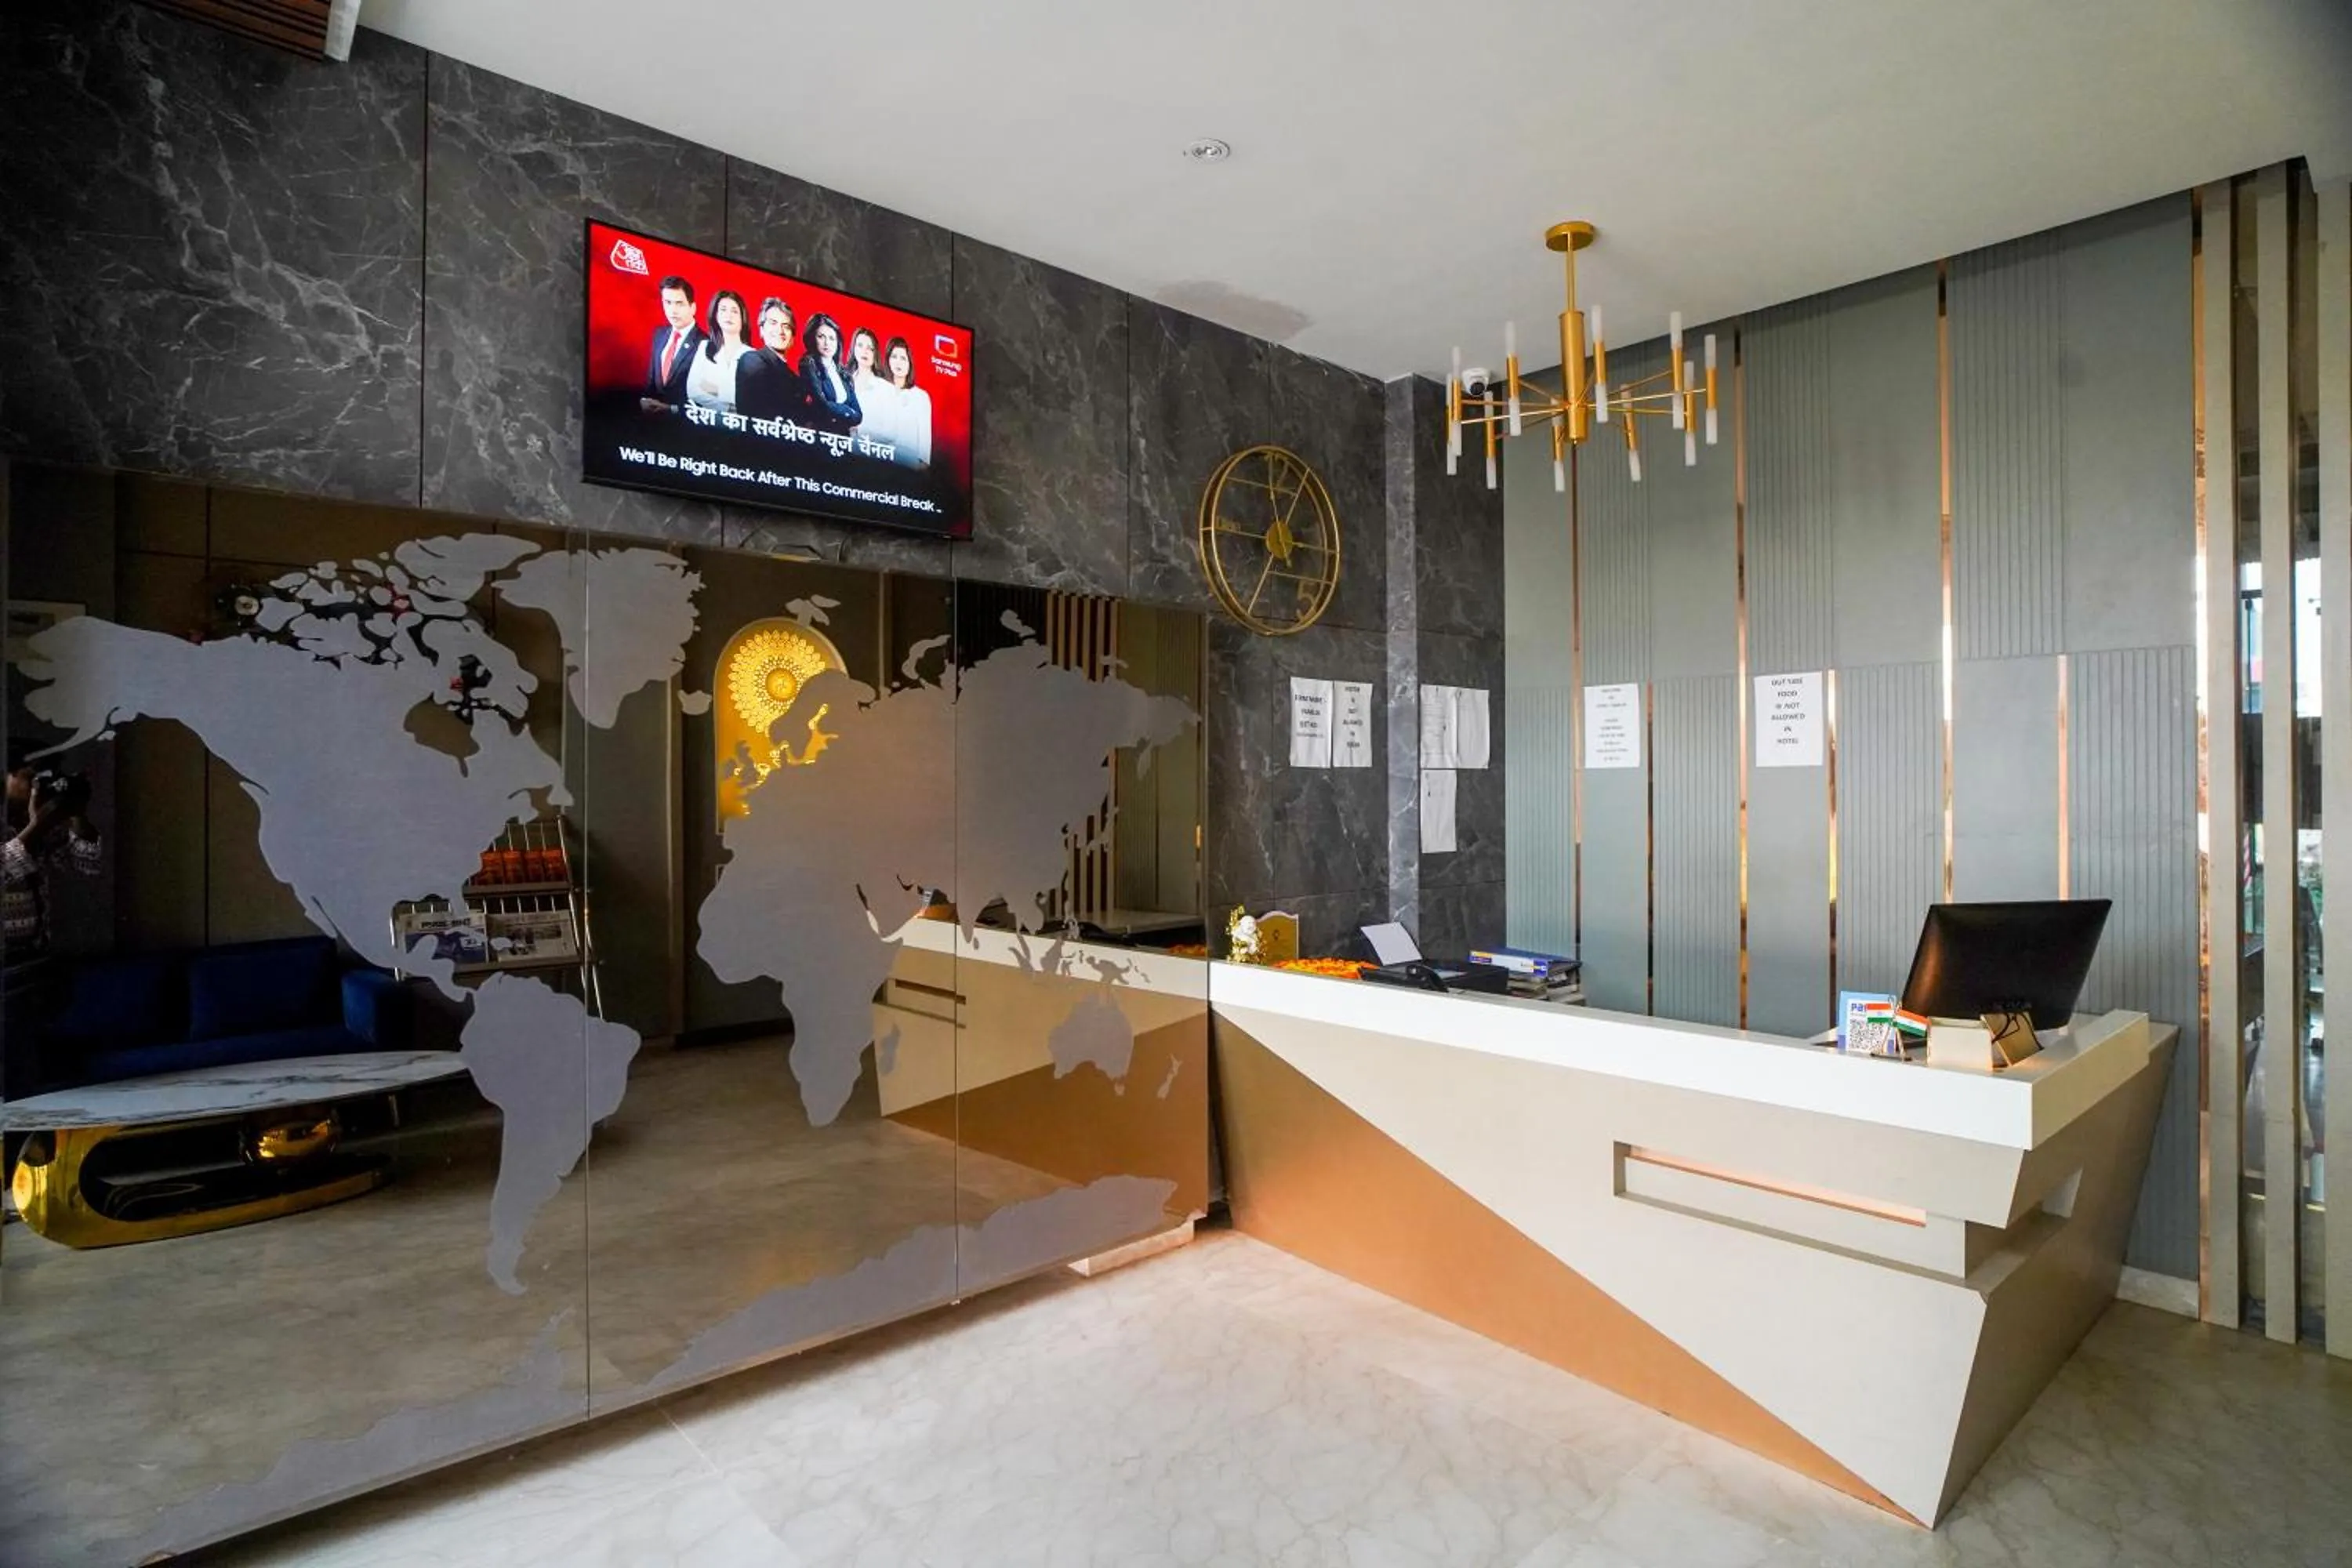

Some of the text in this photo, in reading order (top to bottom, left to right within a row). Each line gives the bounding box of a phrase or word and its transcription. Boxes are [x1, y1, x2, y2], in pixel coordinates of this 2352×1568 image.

[684, 400, 717, 426] देश
[721, 411, 748, 432] का
[752, 416, 816, 445] सर्वश्रेष्ठ
[857, 435, 895, 461] चैनल
[619, 446, 655, 465] We'll
[658, 452, 677, 468] Be
[680, 457, 717, 477] Right
[720, 463, 755, 481] Back
[757, 470, 792, 487] After
[794, 476, 820, 493] This
[822, 482, 898, 506] Commercial
